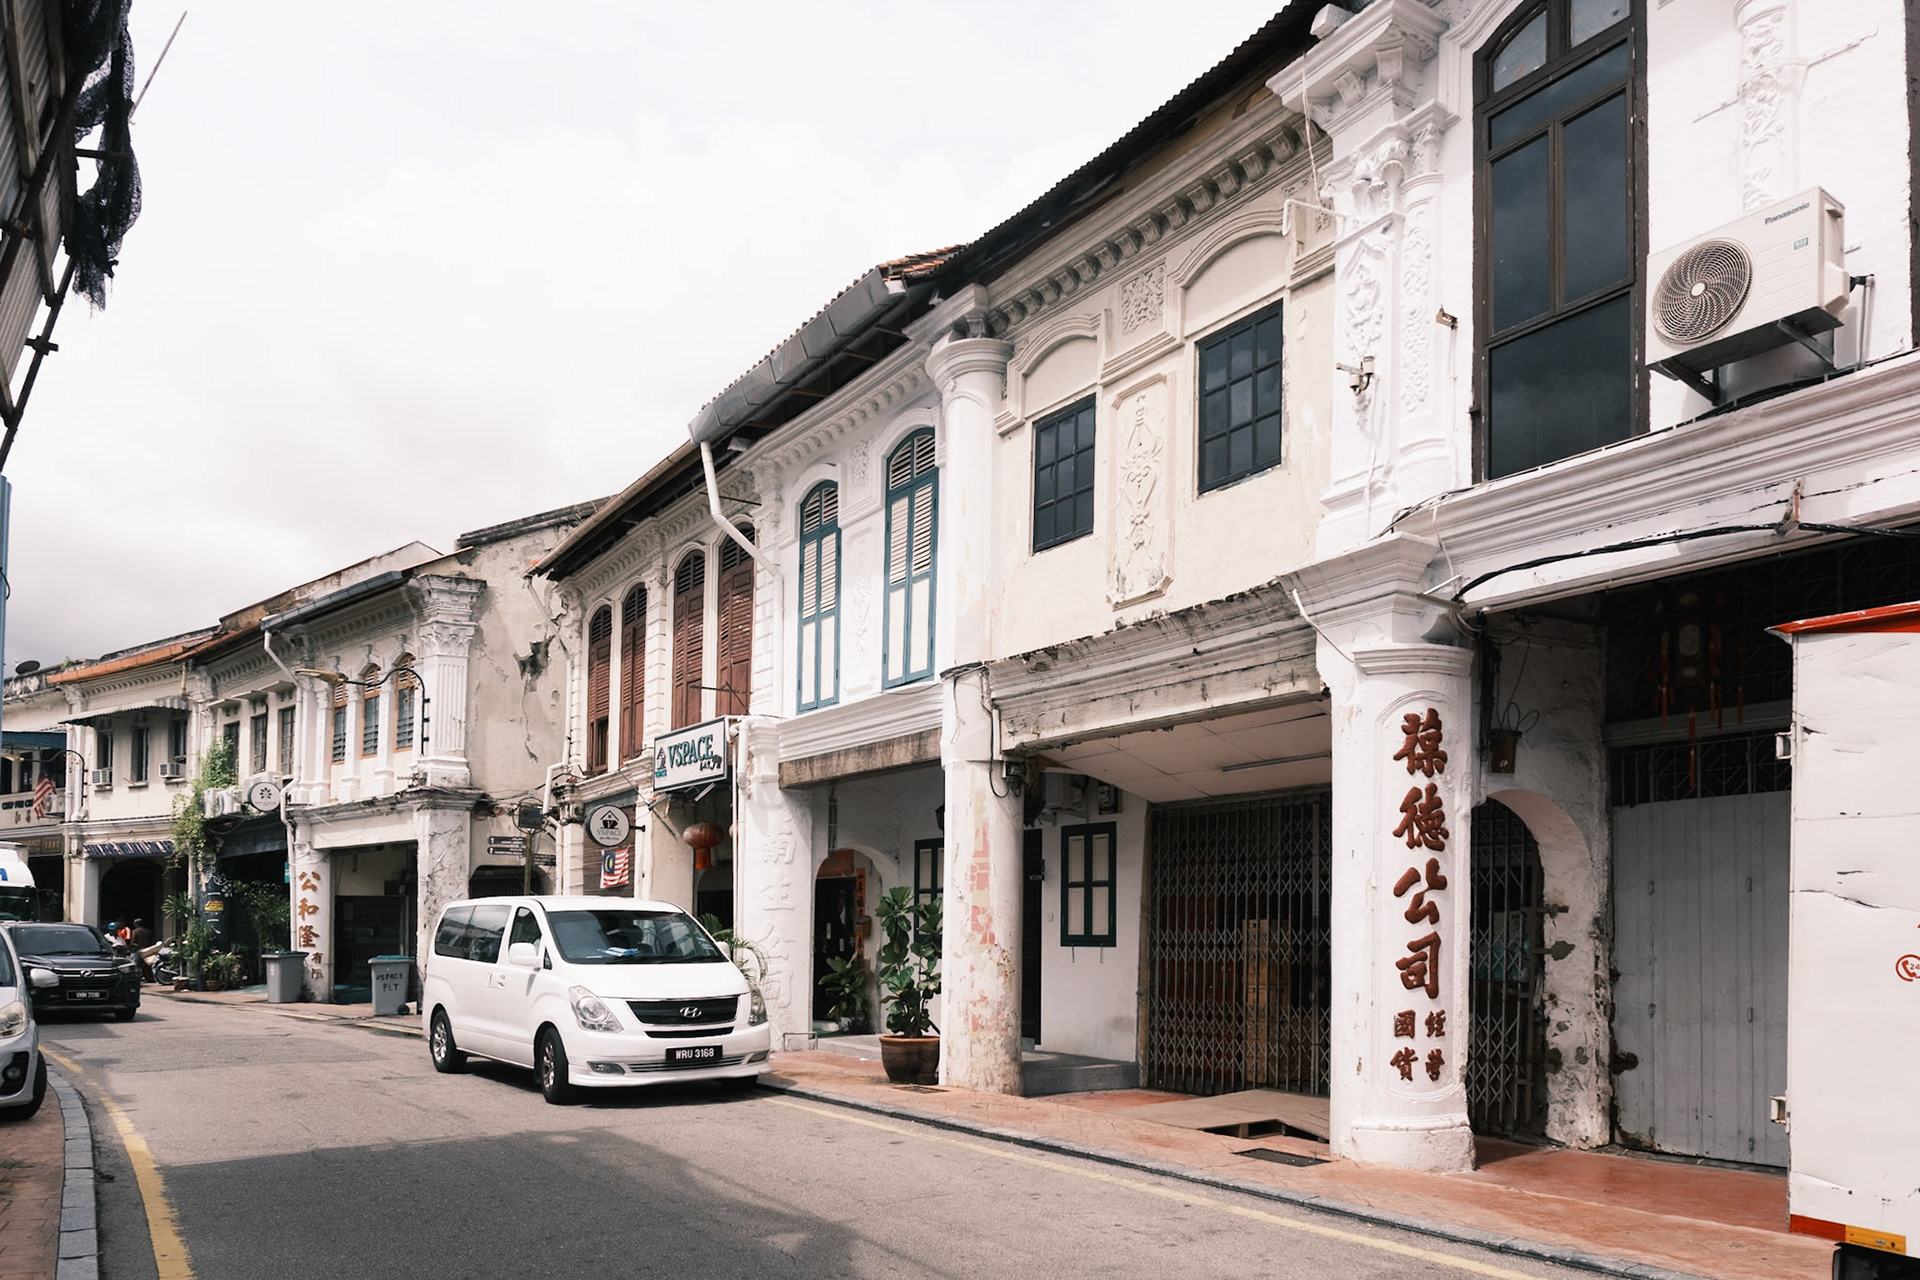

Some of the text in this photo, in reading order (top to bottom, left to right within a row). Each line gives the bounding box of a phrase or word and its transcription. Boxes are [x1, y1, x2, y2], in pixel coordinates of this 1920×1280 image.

[1764, 202, 1810, 225] Panasonic
[668, 734, 714, 769] VSPACE
[298, 871, 322, 949] 公和隆
[375, 972, 404, 981] VSPACE
[382, 983, 400, 992] PLT
[675, 1047, 715, 1060] WRU 3168
